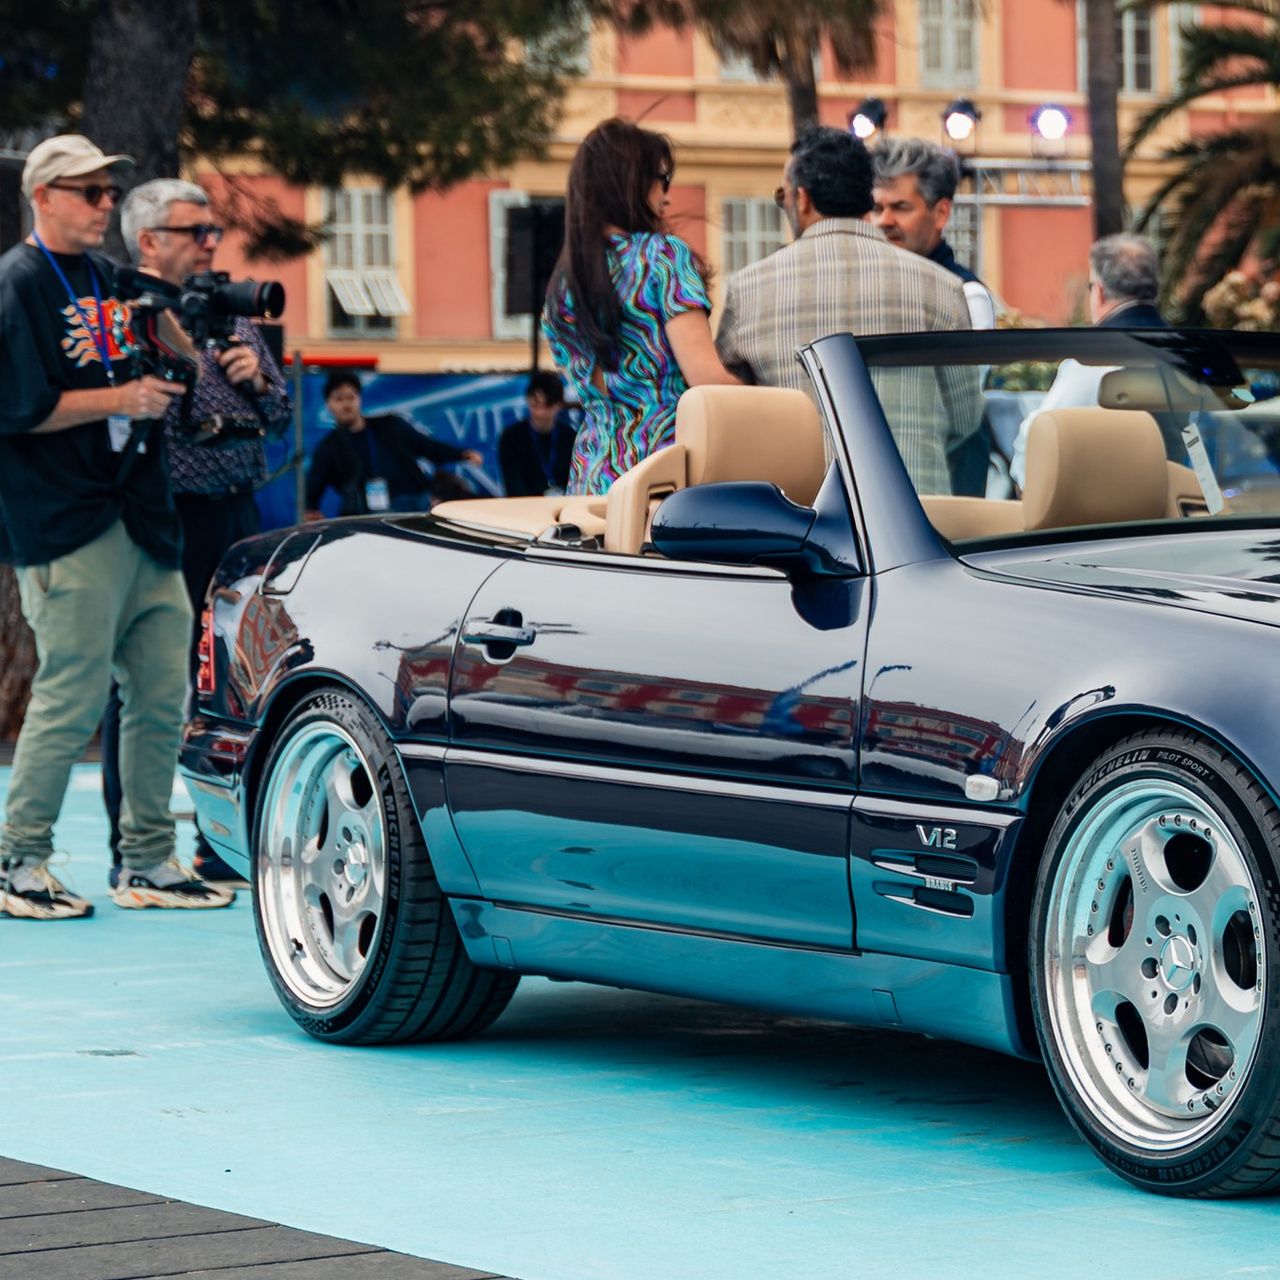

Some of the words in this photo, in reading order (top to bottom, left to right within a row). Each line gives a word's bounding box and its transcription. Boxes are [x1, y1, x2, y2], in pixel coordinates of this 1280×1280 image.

[1082, 749, 1151, 795] MICHELIN
[1156, 750, 1182, 763] PILOT
[1181, 757, 1210, 777] SPORT
[385, 794, 399, 902] MICHELIN
[916, 824, 957, 850] V12
[925, 877, 953, 892] BRABUS
[1158, 1140, 1230, 1181] MICHELIN
